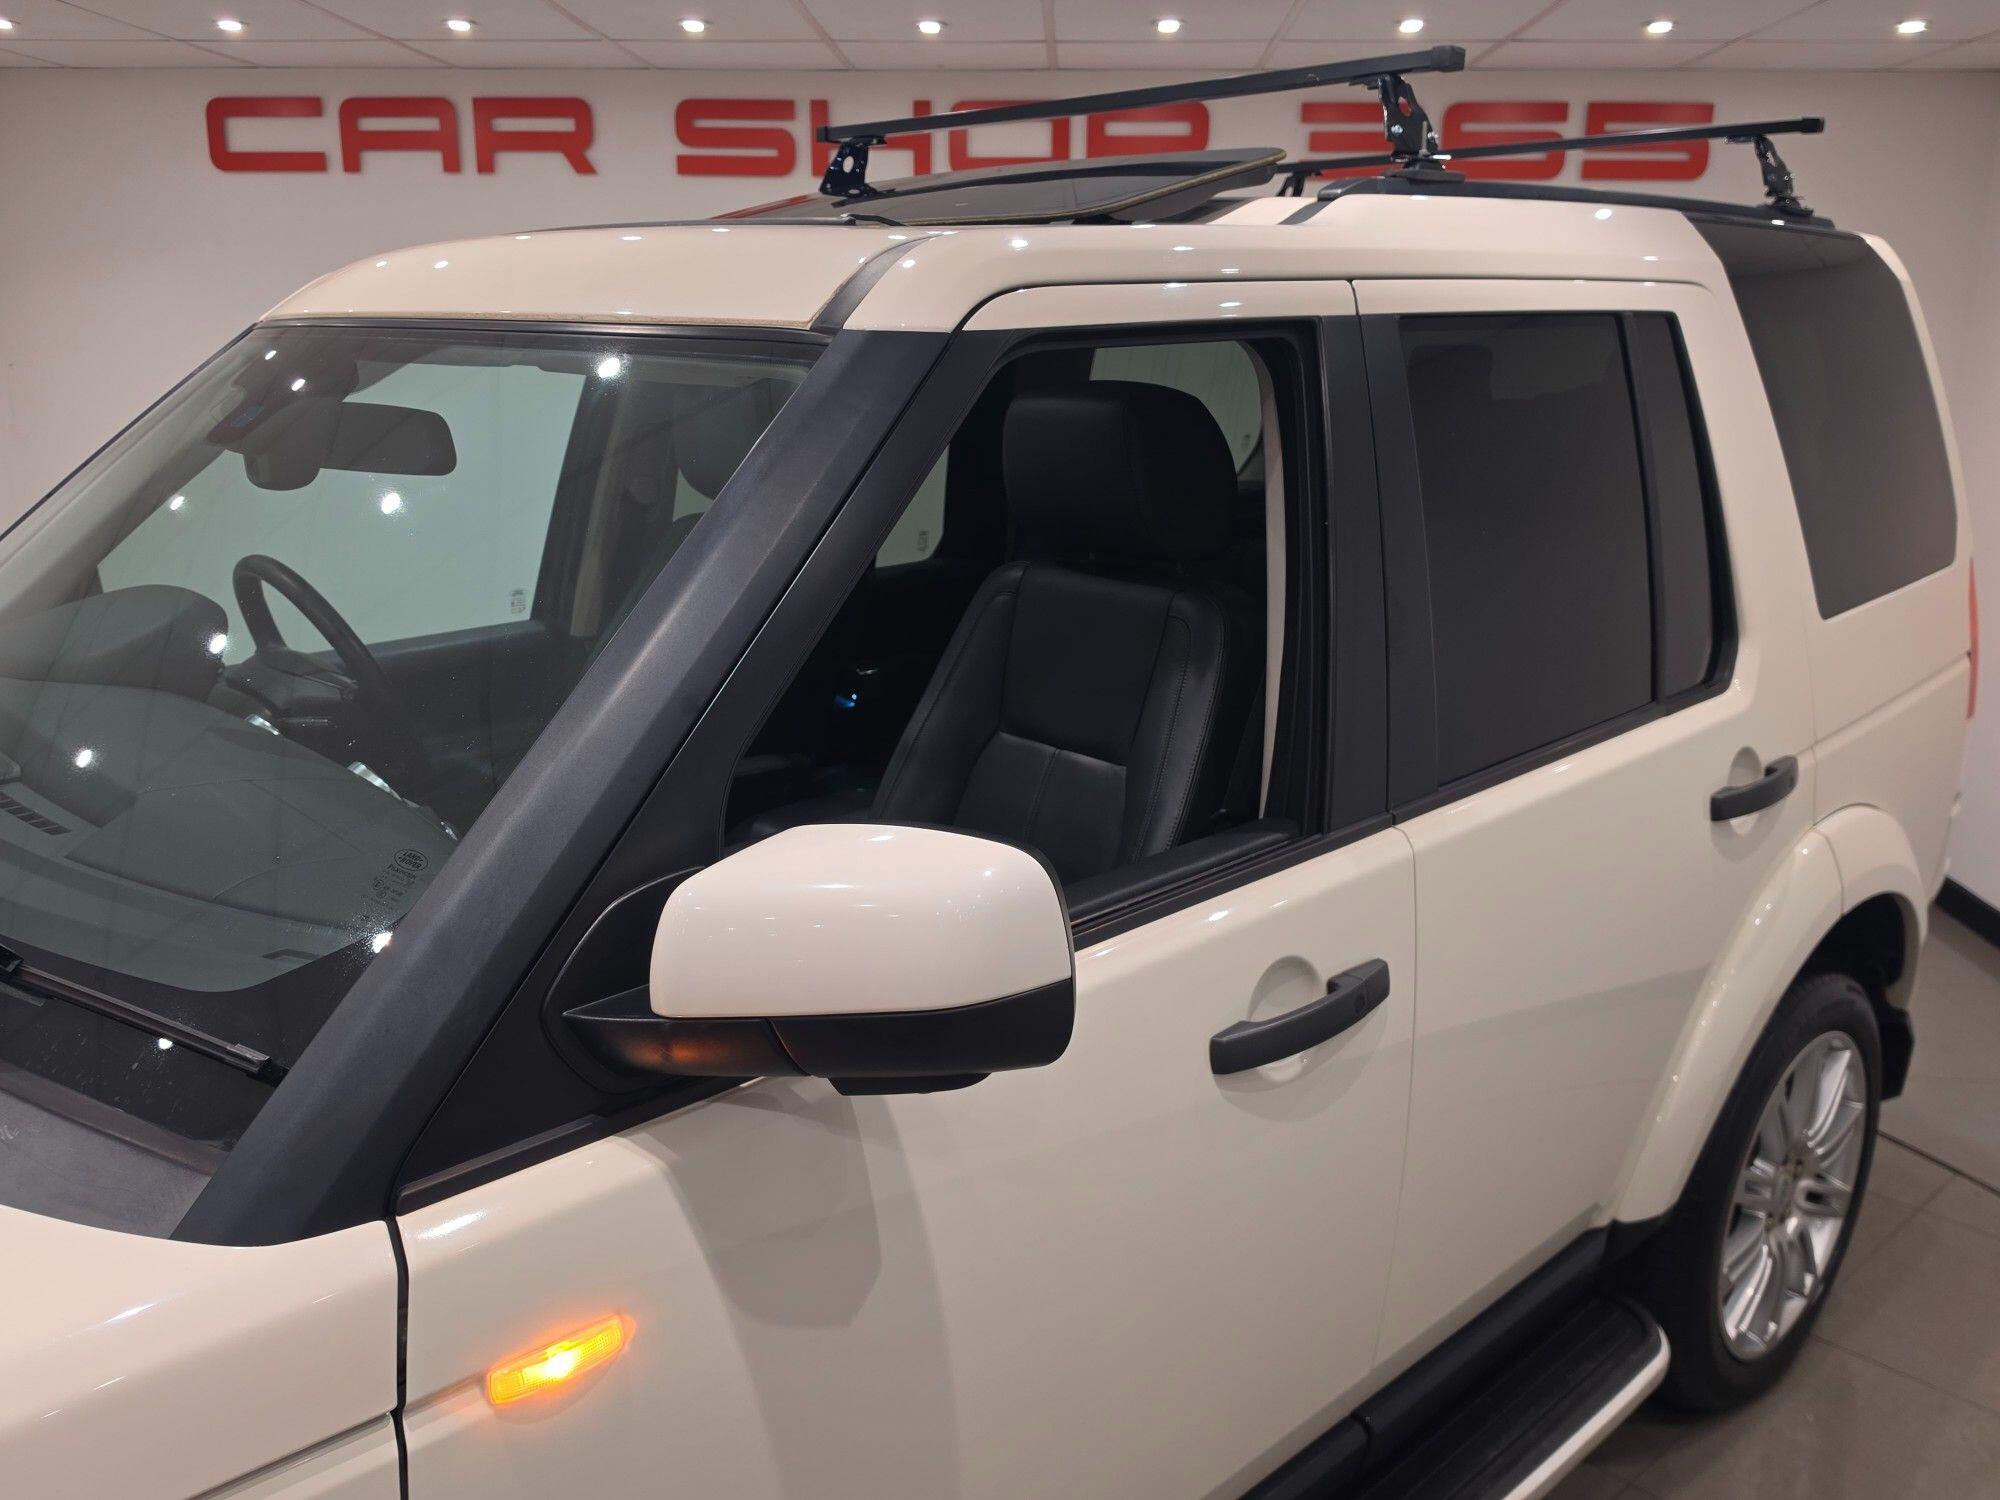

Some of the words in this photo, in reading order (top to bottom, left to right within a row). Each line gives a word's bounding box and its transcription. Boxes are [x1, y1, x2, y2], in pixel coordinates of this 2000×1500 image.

[206, 96, 597, 175] CAR
[675, 98, 1209, 177] SHOP
[1302, 101, 1714, 181] 365
